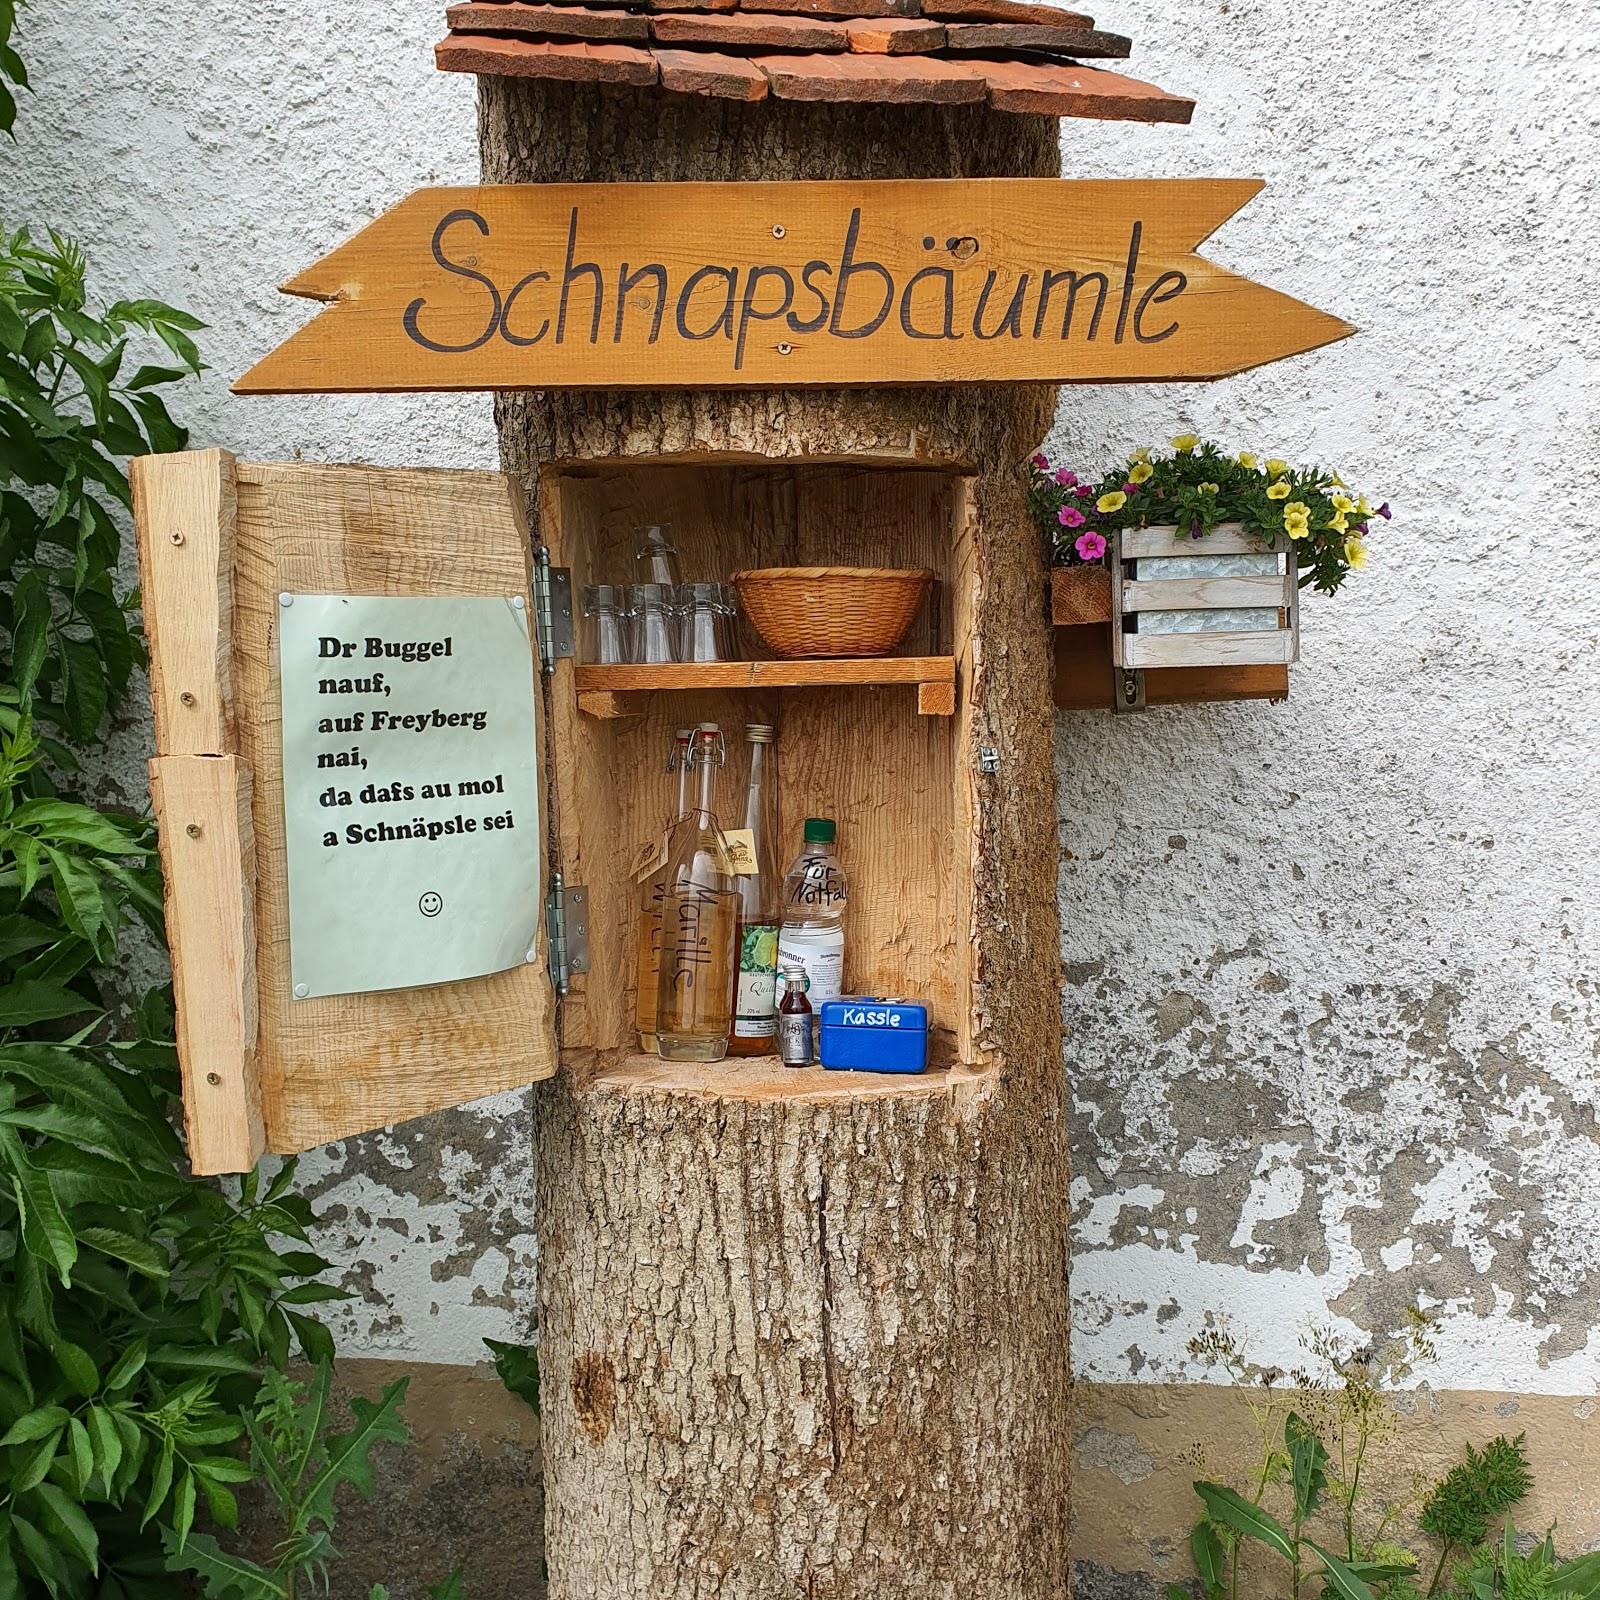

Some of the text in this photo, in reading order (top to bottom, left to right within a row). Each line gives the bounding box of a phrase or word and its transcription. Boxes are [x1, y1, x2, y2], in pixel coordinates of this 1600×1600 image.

[402, 206, 1188, 371] Schnapsbäumle
[318, 637, 452, 662] Dr Buggel
[318, 673, 391, 697] nauf,
[318, 709, 488, 733] auf Freyberg
[317, 746, 368, 770] nai,
[319, 775, 505, 807] da dafs au mol
[323, 810, 515, 847] a Schnäpsle sei
[802, 856, 837, 880] Für
[779, 946, 806, 964] bronner
[842, 1007, 901, 1027] Kässle
